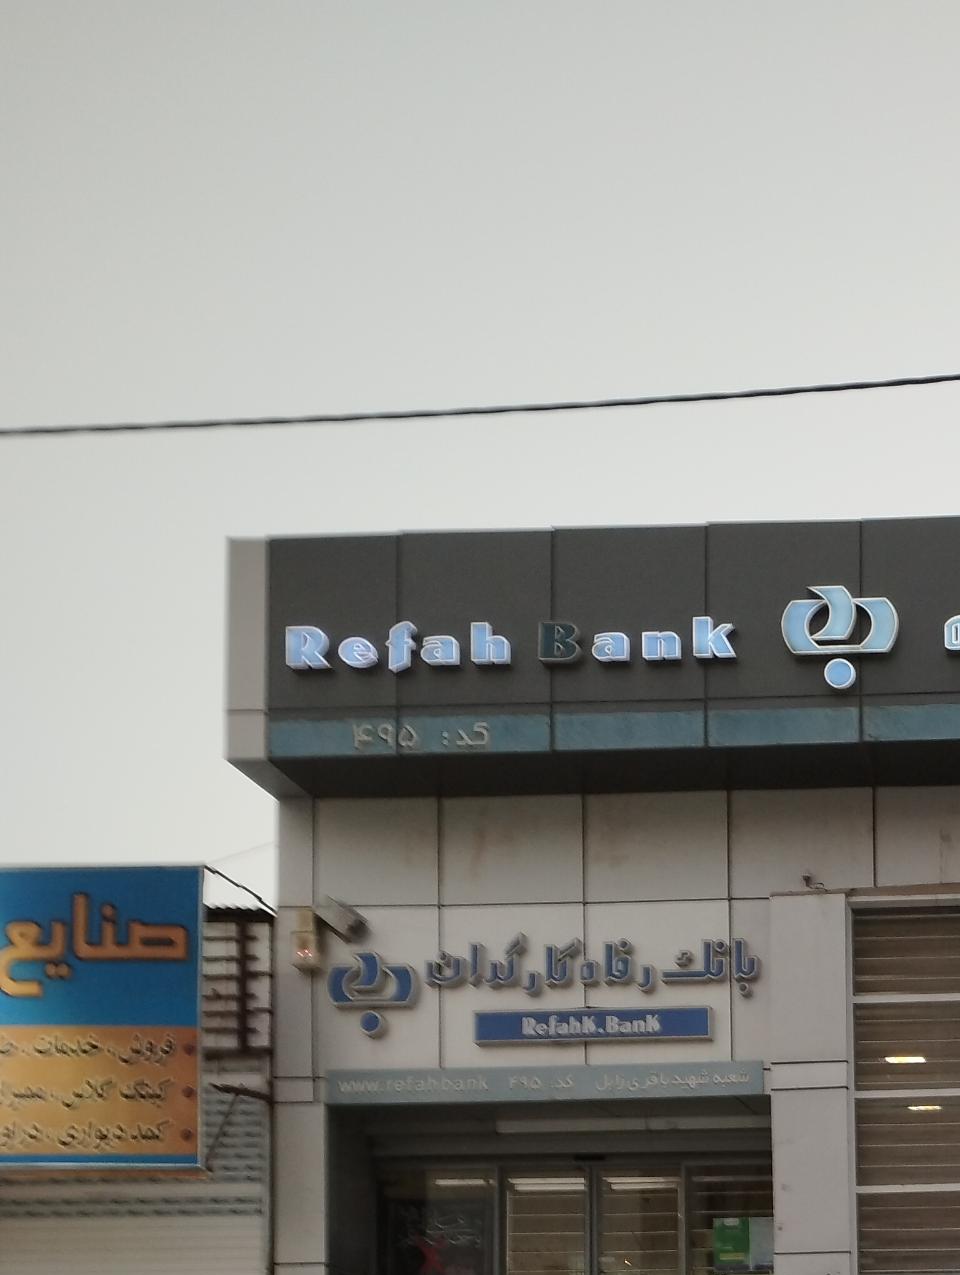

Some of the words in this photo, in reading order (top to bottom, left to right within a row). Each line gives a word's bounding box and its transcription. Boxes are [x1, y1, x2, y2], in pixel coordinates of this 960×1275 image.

[285, 620, 512, 674] Refah
[538, 616, 738, 665] Bank
[0, 891, 190, 998] صنایع
[424, 930, 582, 998] کارگران
[581, 936, 656, 993] رفاه
[661, 936, 763, 999] بانک
